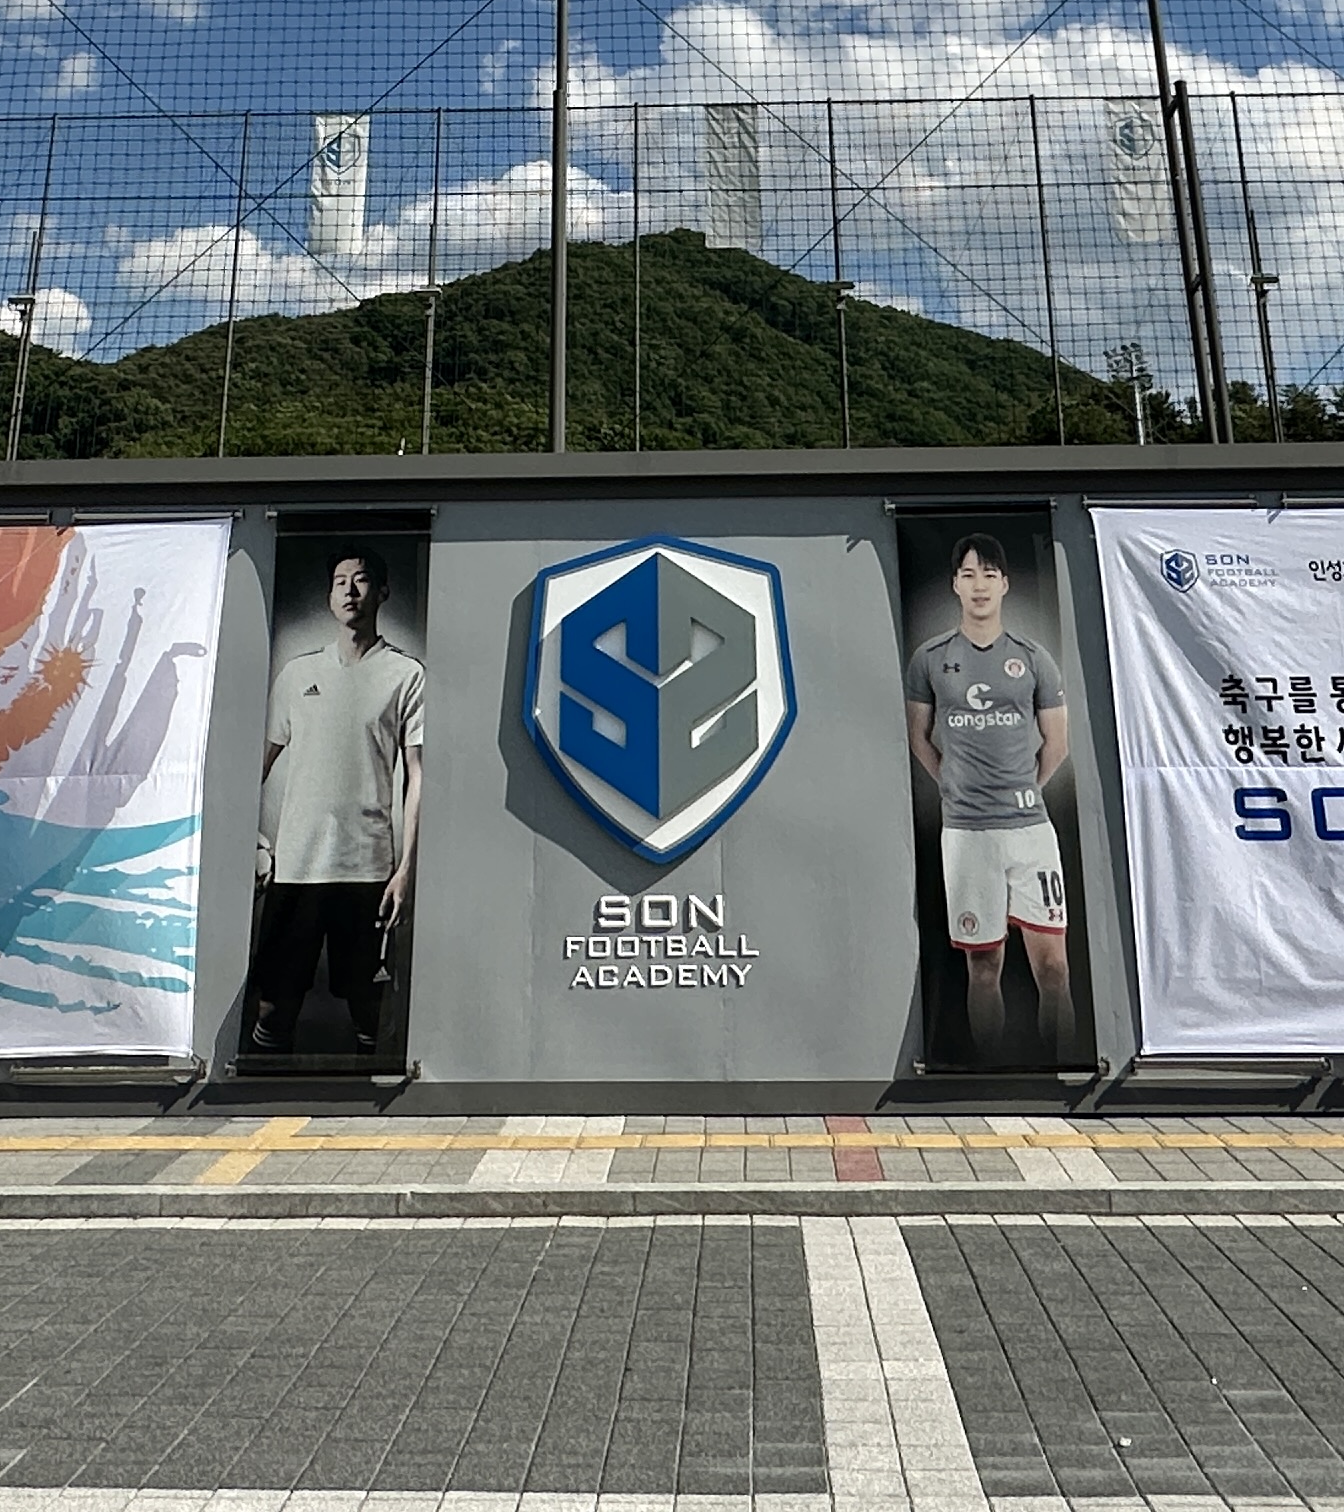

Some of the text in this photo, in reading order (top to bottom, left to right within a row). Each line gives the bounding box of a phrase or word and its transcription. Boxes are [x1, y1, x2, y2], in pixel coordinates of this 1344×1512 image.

[1206, 554, 1250, 566] SON
[1207, 568, 1280, 577] FOOTBALL
[1209, 579, 1277, 588] ACADEMY
[1219, 674, 1317, 715] 축구를
[948, 711, 1022, 731] congstar
[1224, 723, 1326, 764] 행복한
[1014, 789, 1036, 809] 10
[1037, 870, 1064, 907] 10
[597, 894, 725, 929] SON
[565, 934, 760, 959] FOOTBALL
[570, 963, 753, 988] ACADEMY
